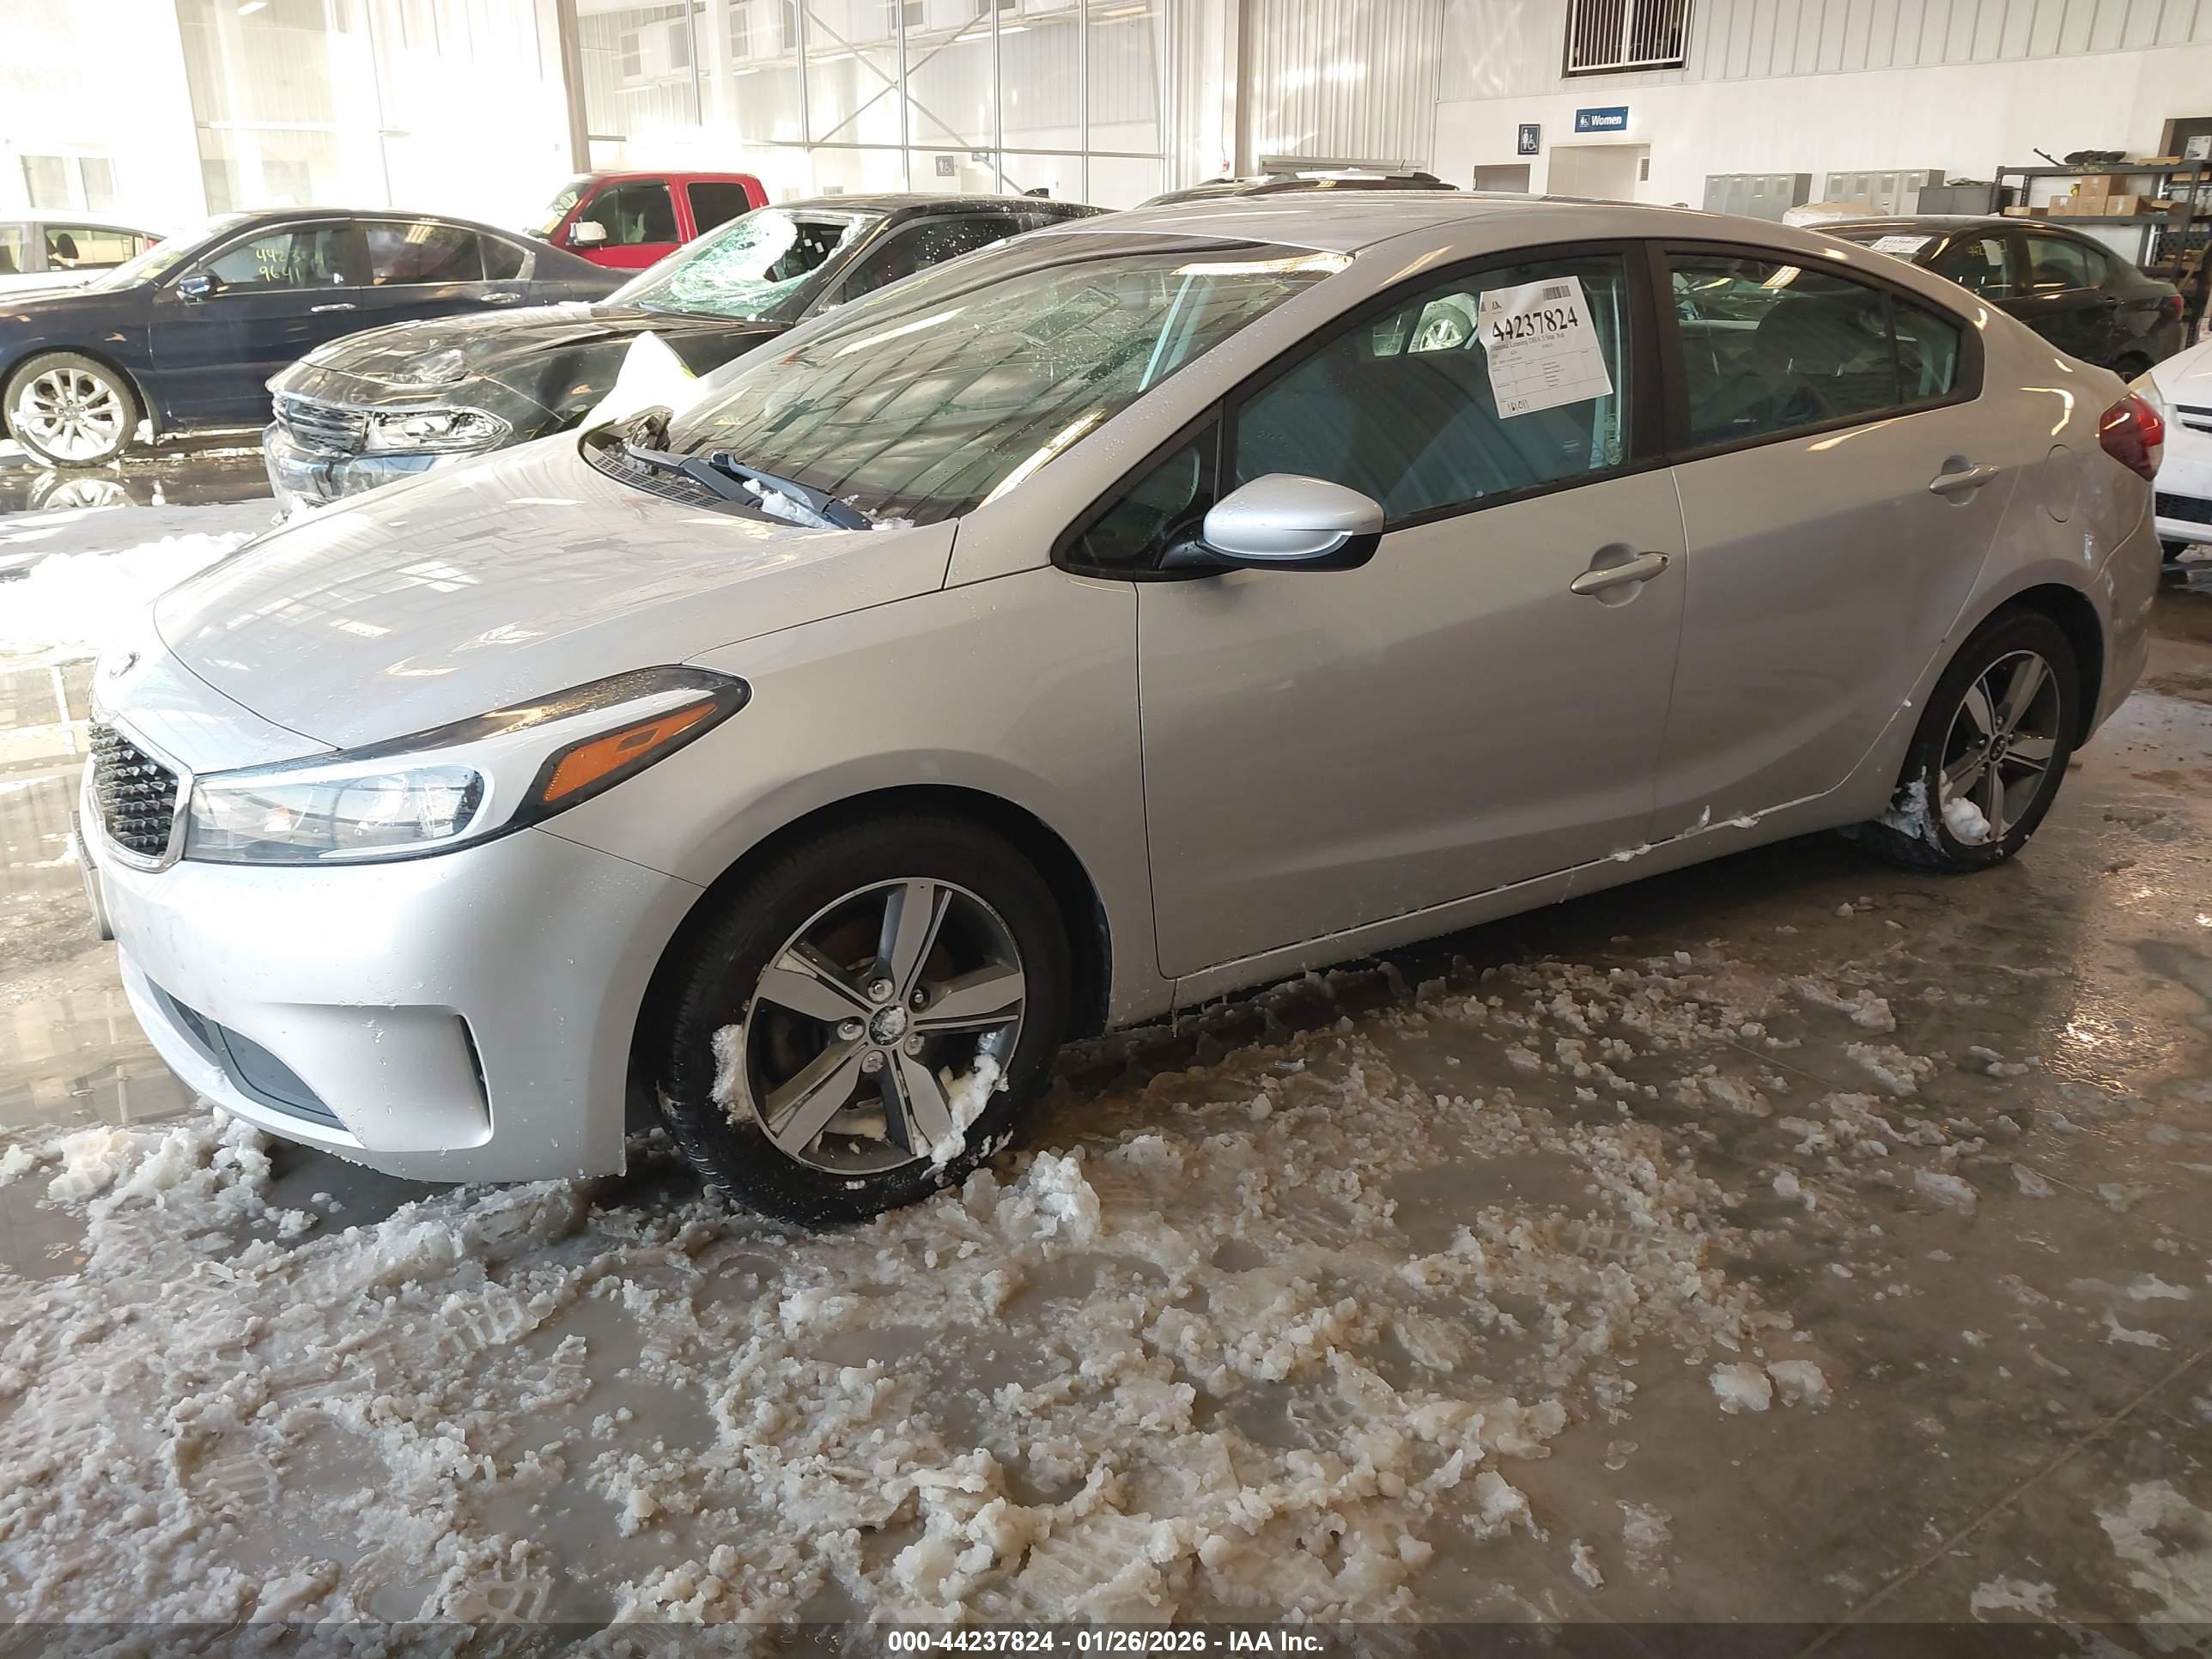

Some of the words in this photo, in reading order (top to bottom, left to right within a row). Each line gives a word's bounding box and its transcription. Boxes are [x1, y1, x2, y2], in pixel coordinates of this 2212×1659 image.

[1591, 115, 1622, 126] Women
[259, 264, 301, 284] 9641
[1492, 306, 1579, 342] 44237824
